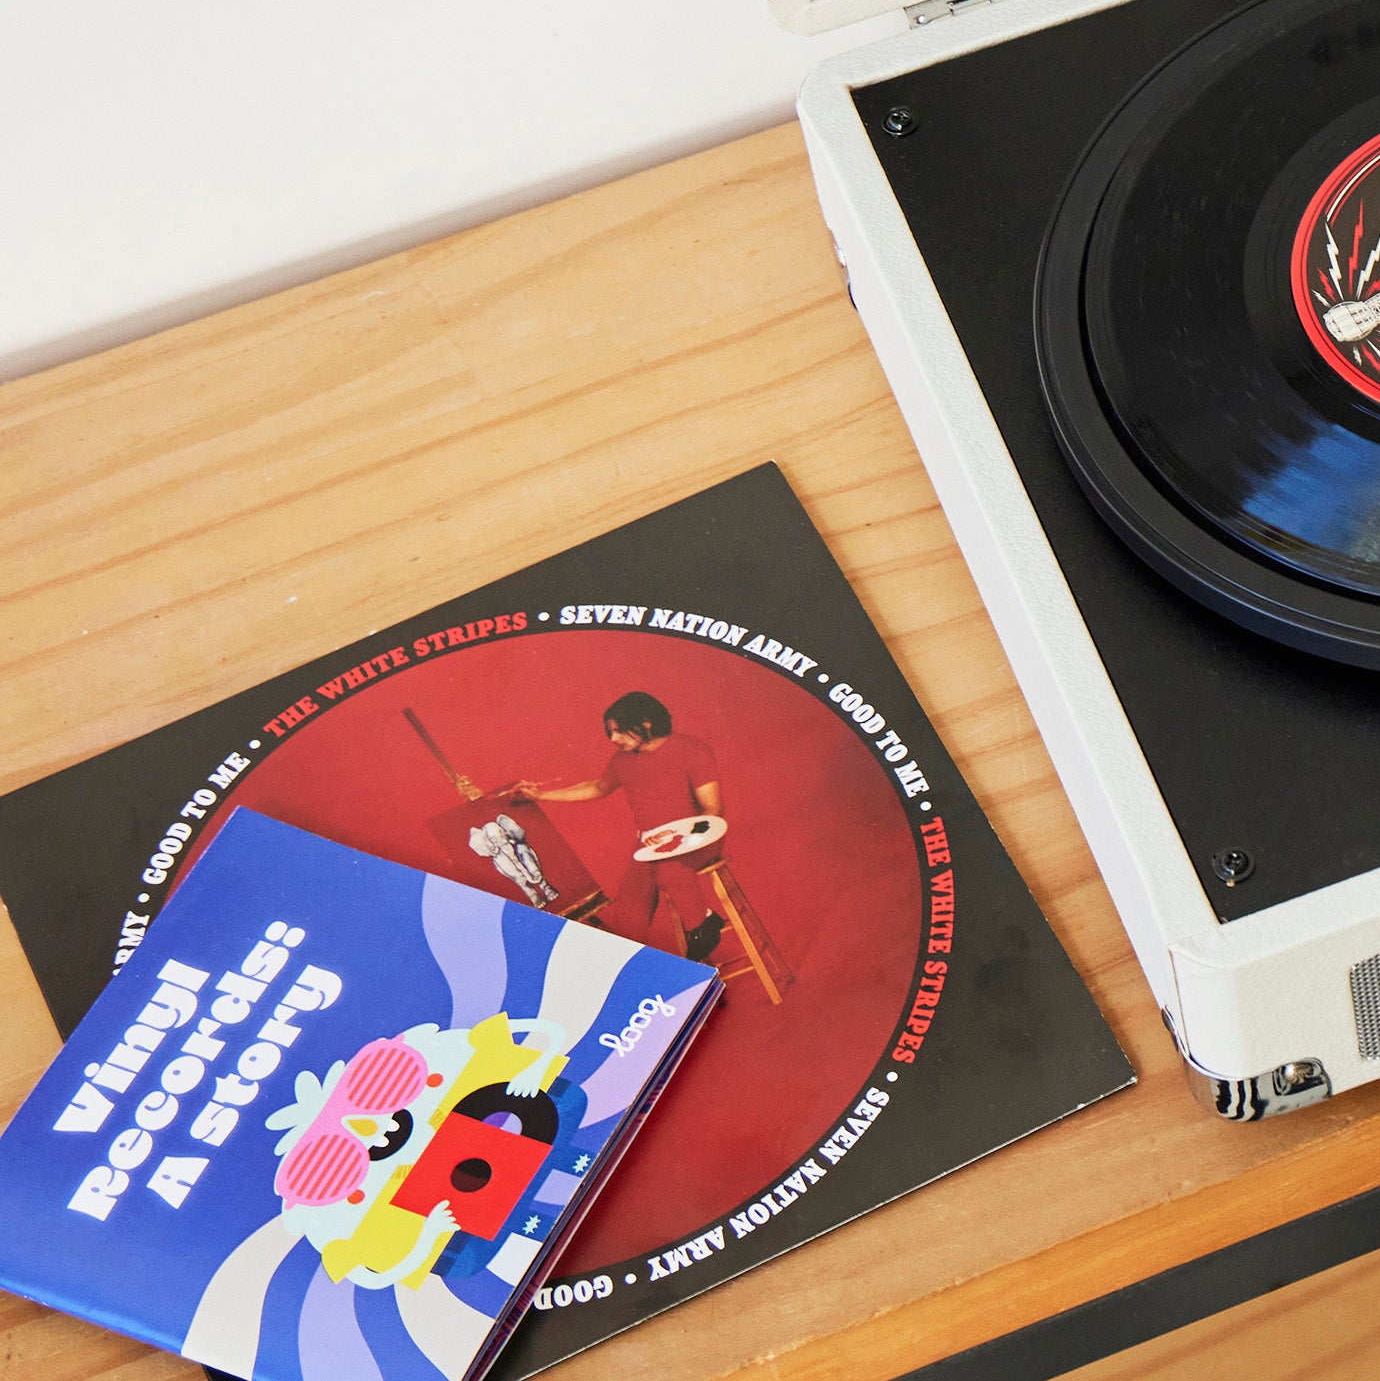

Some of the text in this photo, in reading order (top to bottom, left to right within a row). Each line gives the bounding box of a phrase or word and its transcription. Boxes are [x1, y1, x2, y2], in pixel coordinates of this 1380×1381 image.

[263, 611, 528, 738] THE WHITE STRIPES
[559, 604, 819, 679] SEVEN NATION ARMY
[828, 682, 930, 799] GOOD TO ME
[142, 751, 250, 886] GOOD TO ME
[891, 816, 955, 1065] THE WHITE STRIPES
[52, 958, 211, 1133] Vinyl
[67, 920, 306, 1221] Records:
[146, 964, 343, 1210] A story
[599, 994, 677, 1058] loog
[647, 1086, 890, 1283] SEVEN NATION ARMY
[533, 1275, 614, 1311] GOOD
